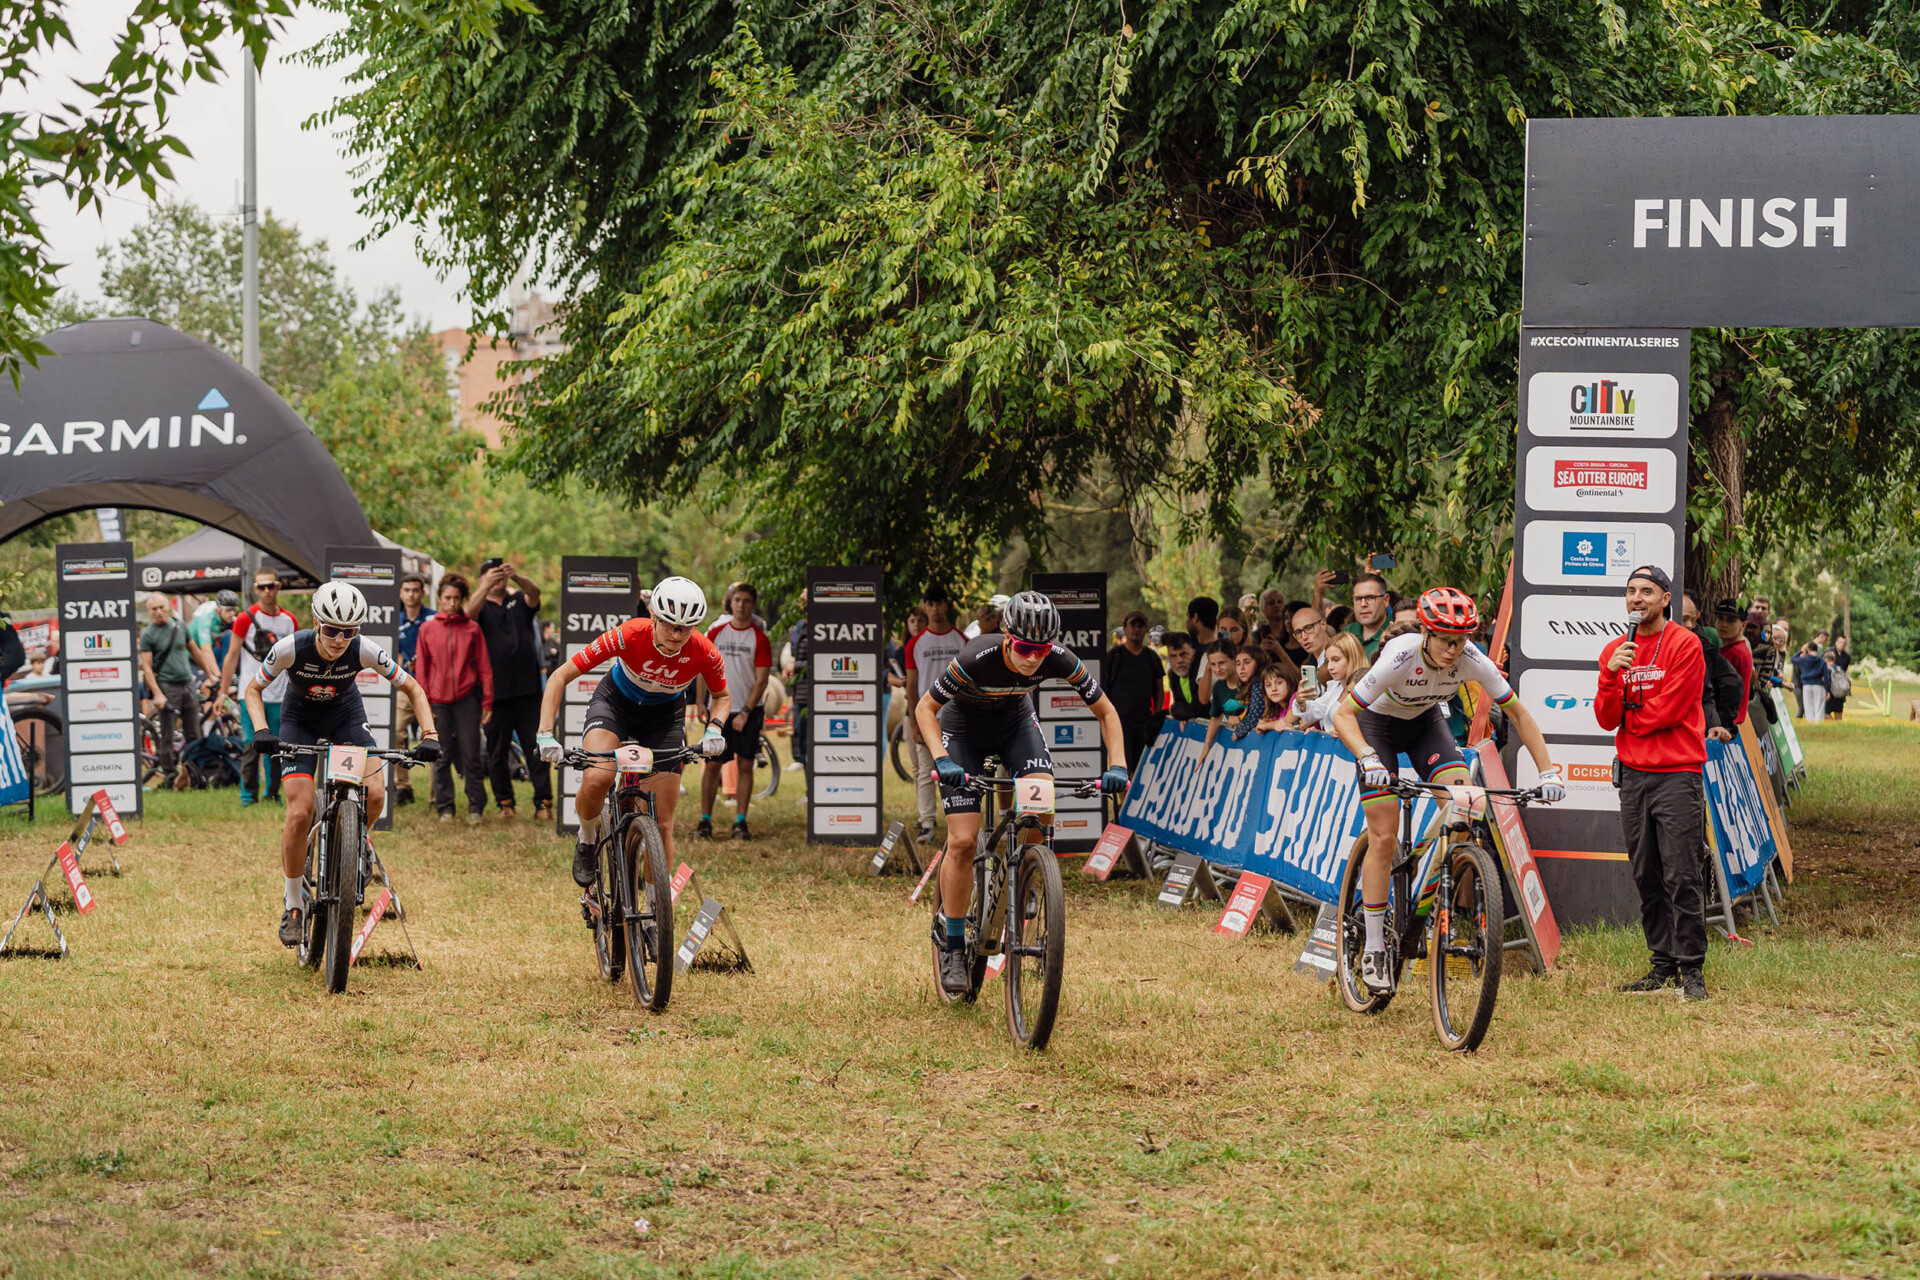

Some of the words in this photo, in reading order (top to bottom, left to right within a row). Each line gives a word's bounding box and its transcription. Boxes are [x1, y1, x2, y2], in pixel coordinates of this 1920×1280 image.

[1633, 197, 1848, 249] FINISH
[1530, 336, 1680, 348] #XCECONTINENTALSERIES
[1570, 379, 1636, 415] CITY
[1570, 415, 1635, 427] MOUNTAINBIKE
[0, 412, 235, 456] ARMIN
[1557, 470, 1575, 486] SEA
[1577, 471, 1607, 485] OTTER
[1608, 472, 1645, 488] EUROPE
[1576, 488, 1618, 498] Continental
[64, 599, 130, 619] START
[813, 623, 877, 641] START
[1548, 620, 1629, 636] CANYO
[84, 633, 112, 648] CITY
[975, 645, 999, 660] SCOTT
[831, 656, 859, 671] CITY
[1409, 679, 1428, 687] UCI
[629, 749, 640, 761] 3
[824, 755, 865, 763] CANYON
[82, 763, 122, 772] GARMIN
[341, 756, 354, 771] 4
[1029, 785, 1042, 801] 2
